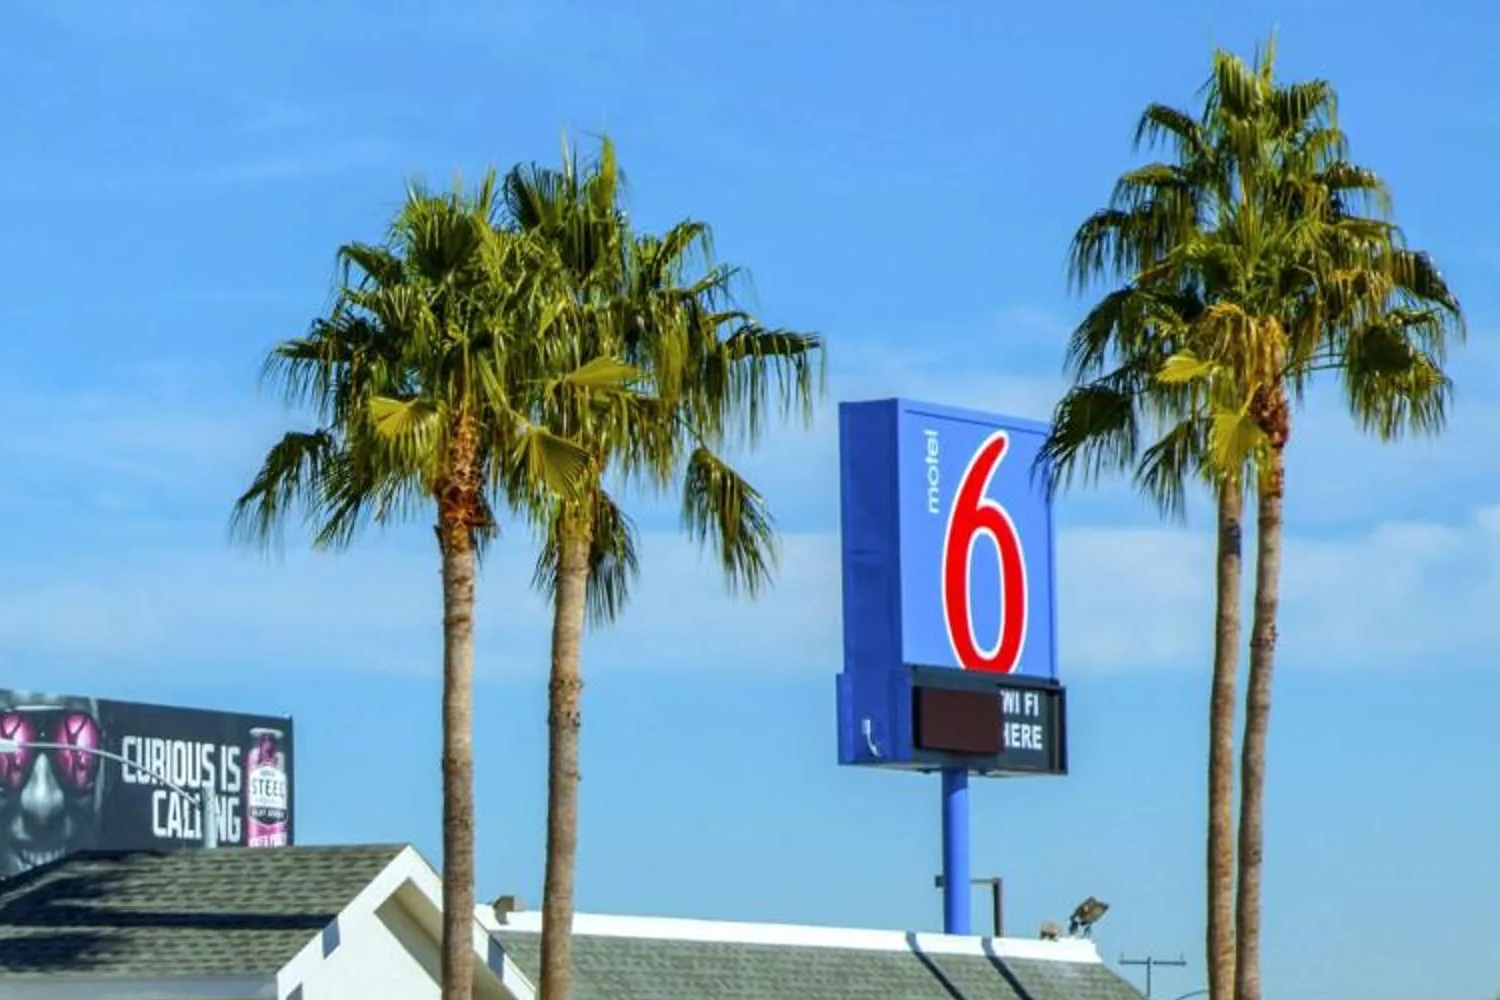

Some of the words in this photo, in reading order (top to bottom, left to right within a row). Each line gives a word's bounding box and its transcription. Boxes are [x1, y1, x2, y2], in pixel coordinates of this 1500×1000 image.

[922, 428, 940, 513] motel
[942, 430, 1028, 674] 6
[1025, 691, 1039, 717] FI
[121, 736, 216, 788] CURIOUS
[221, 745, 241, 792] IS
